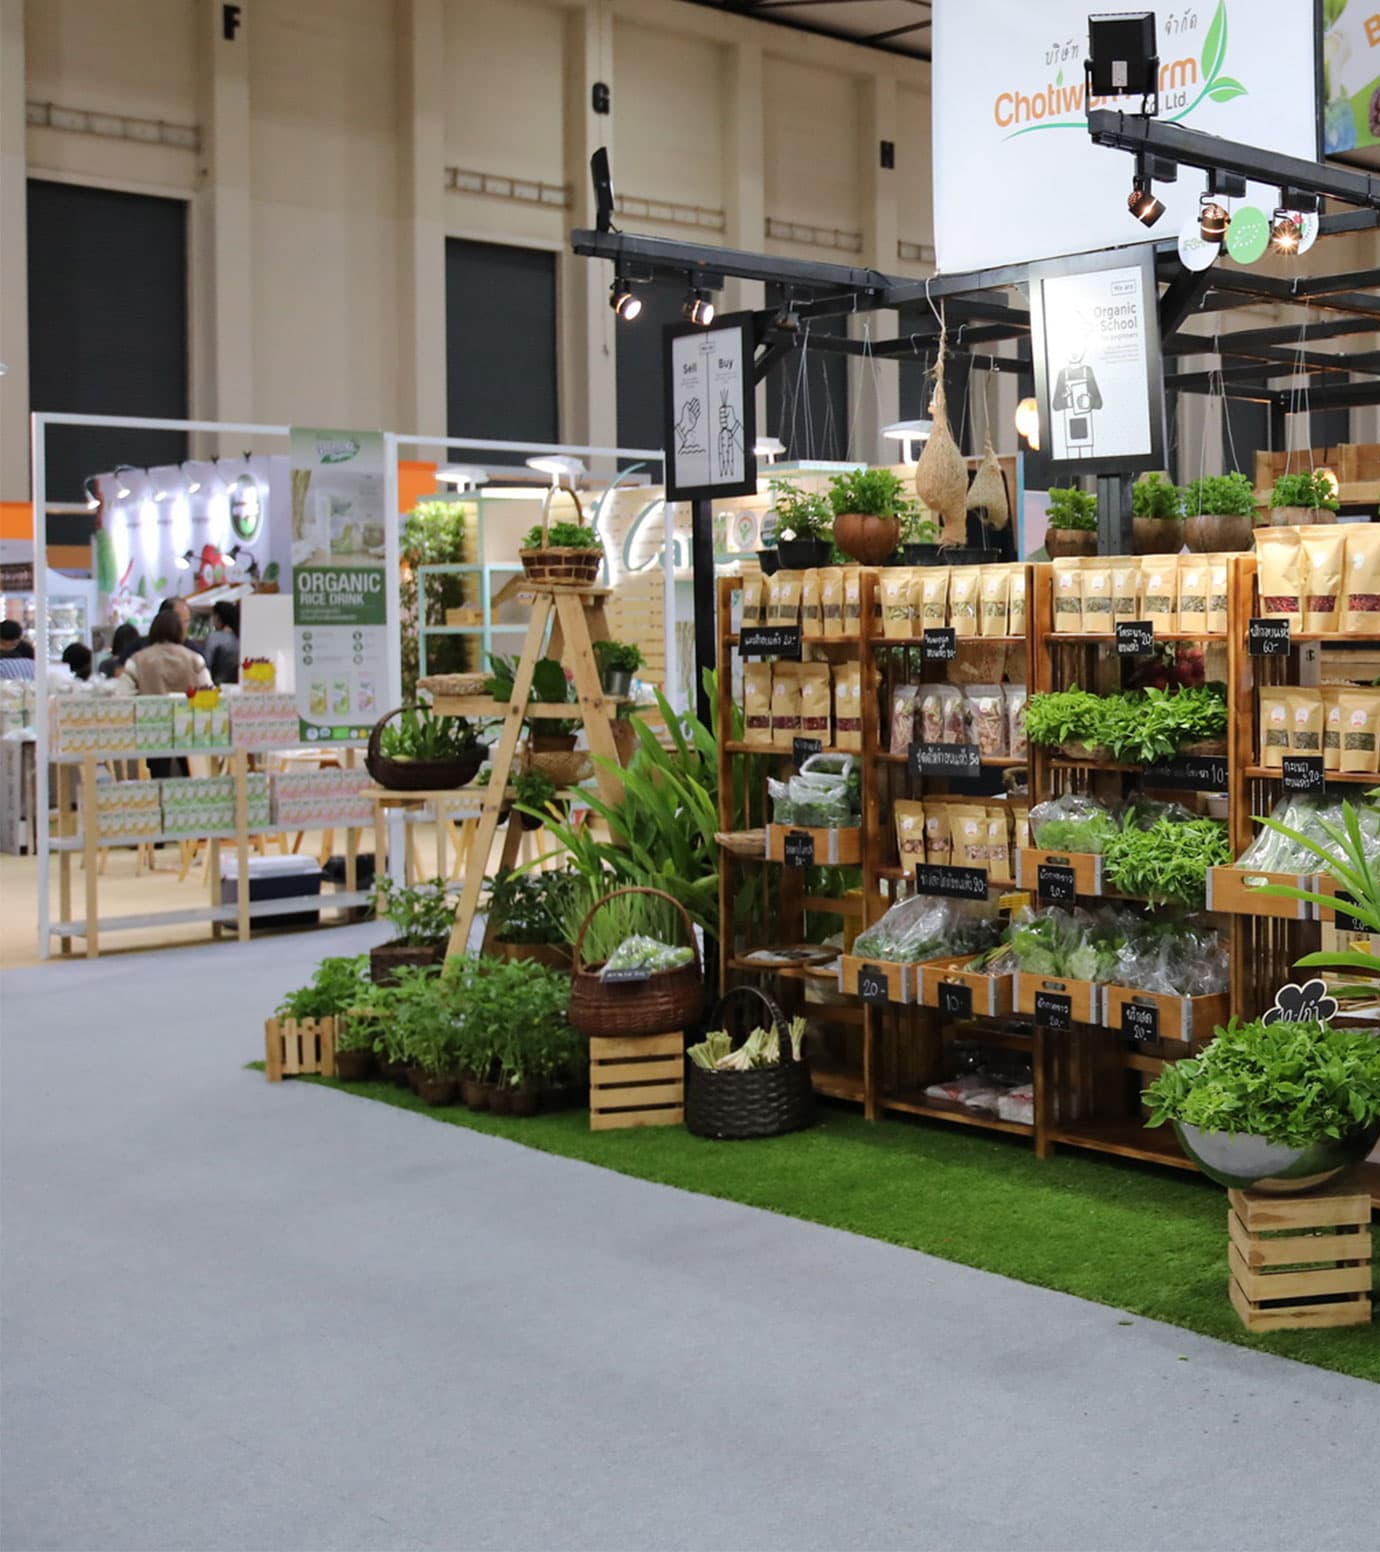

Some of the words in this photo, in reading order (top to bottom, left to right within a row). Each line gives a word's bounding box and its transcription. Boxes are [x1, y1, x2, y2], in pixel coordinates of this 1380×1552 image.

[222, 5, 241, 40] F
[592, 82, 610, 115] G
[1165, 92, 1189, 110] Ltd.
[1094, 302, 1137, 320] Organic
[1101, 317, 1138, 332] School
[682, 362, 697, 375] Sell
[718, 358, 733, 370] Buy
[298, 571, 381, 593] ORGANIC
[300, 593, 326, 606] RICE
[329, 593, 365, 607] DRINK
